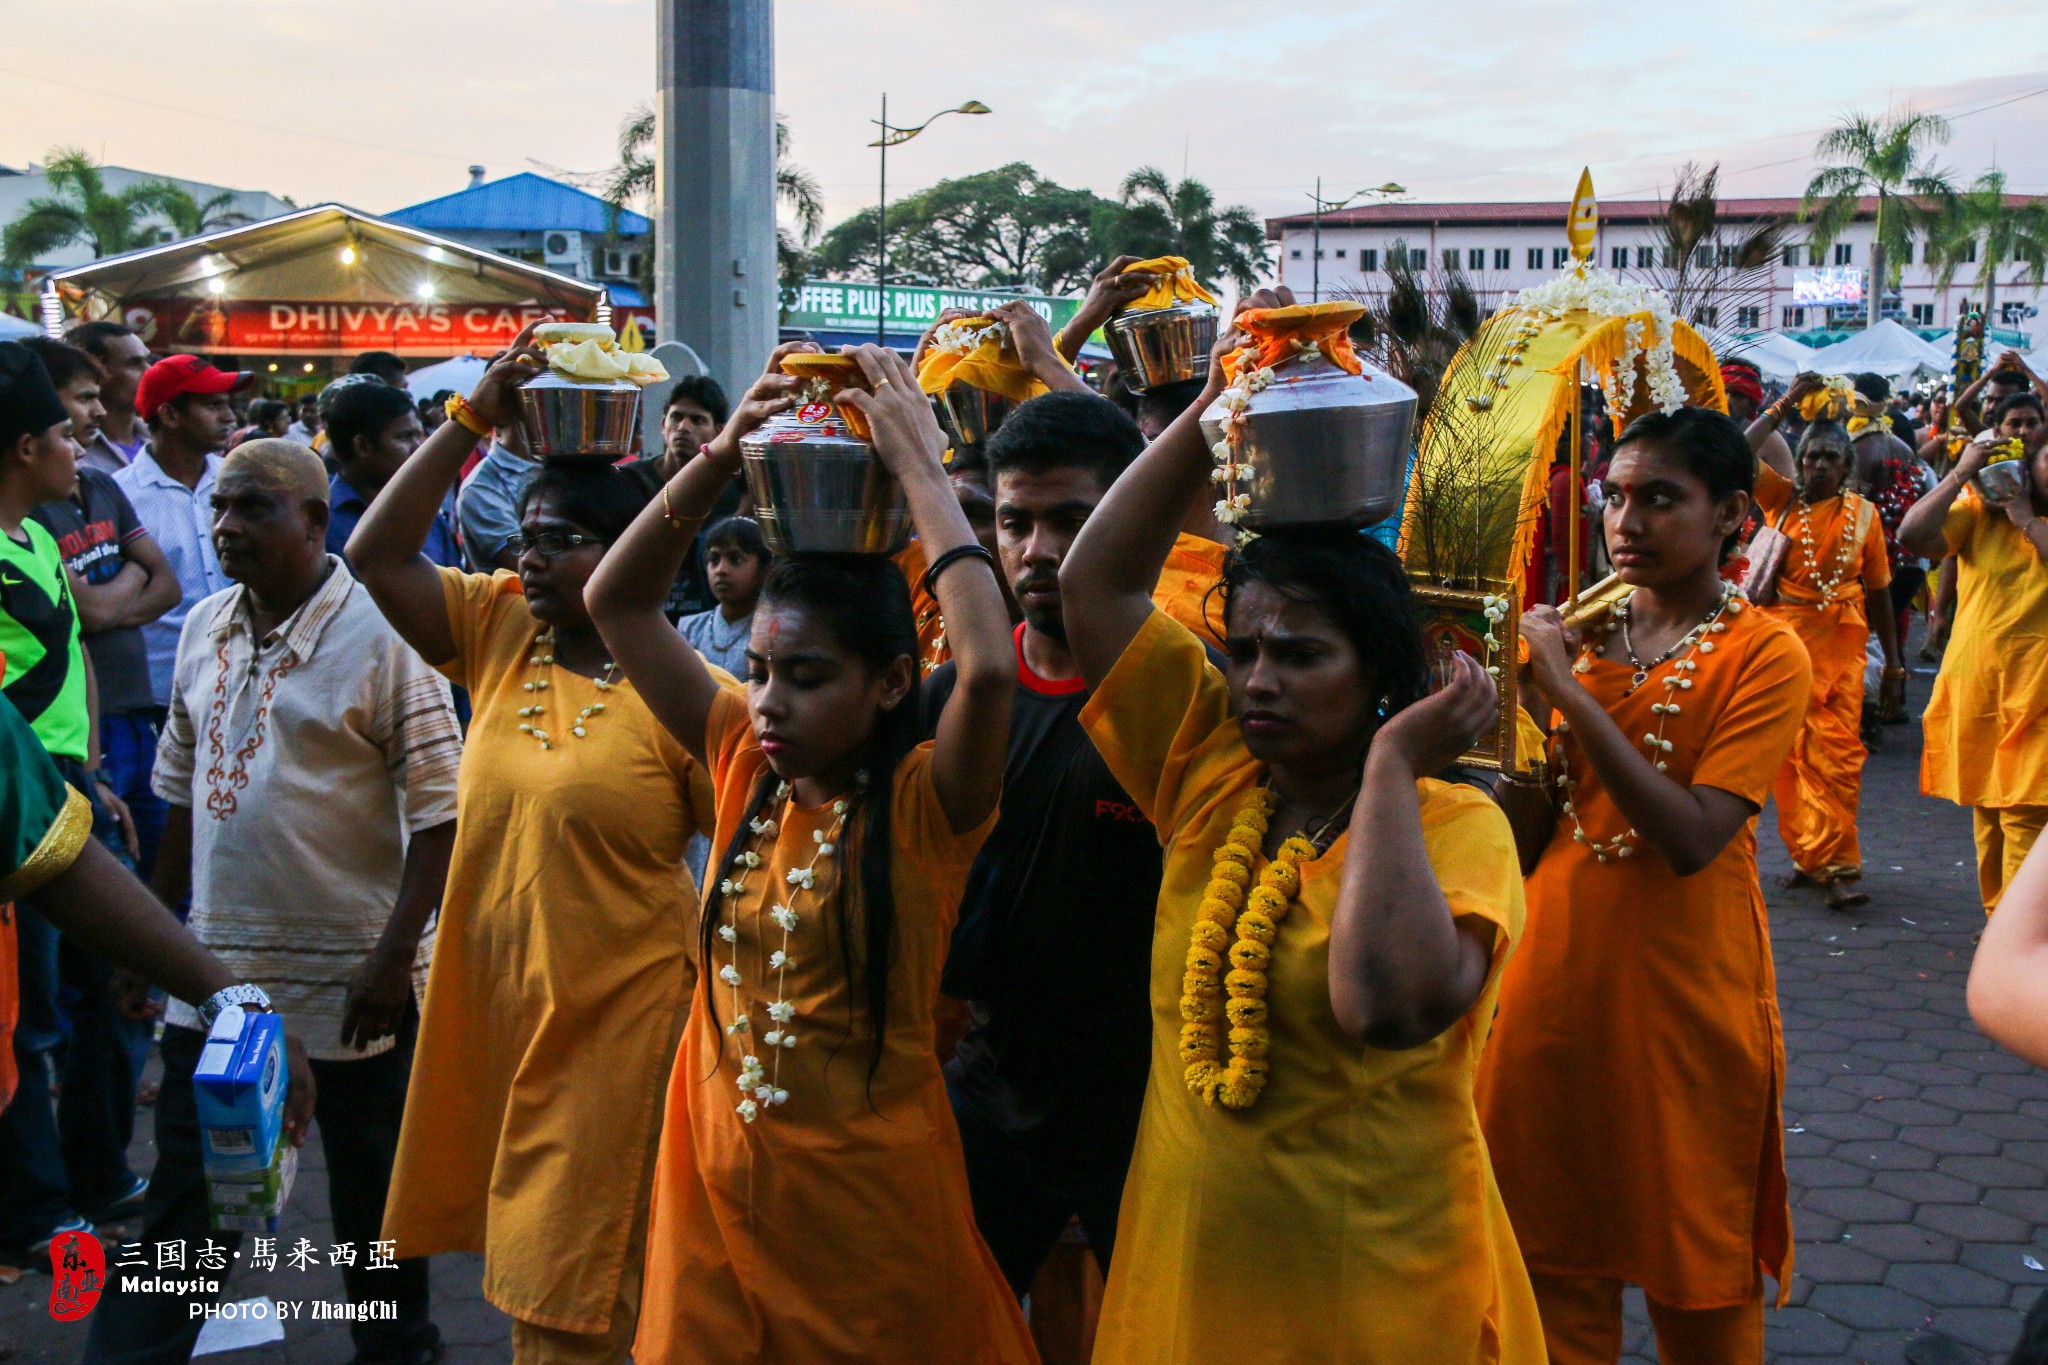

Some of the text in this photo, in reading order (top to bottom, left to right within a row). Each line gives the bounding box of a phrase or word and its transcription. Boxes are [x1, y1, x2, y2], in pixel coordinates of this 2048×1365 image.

[269, 302, 452, 333] DHIVYA'S
[847, 288, 891, 317] PLUS
[895, 291, 936, 319] PLUS
